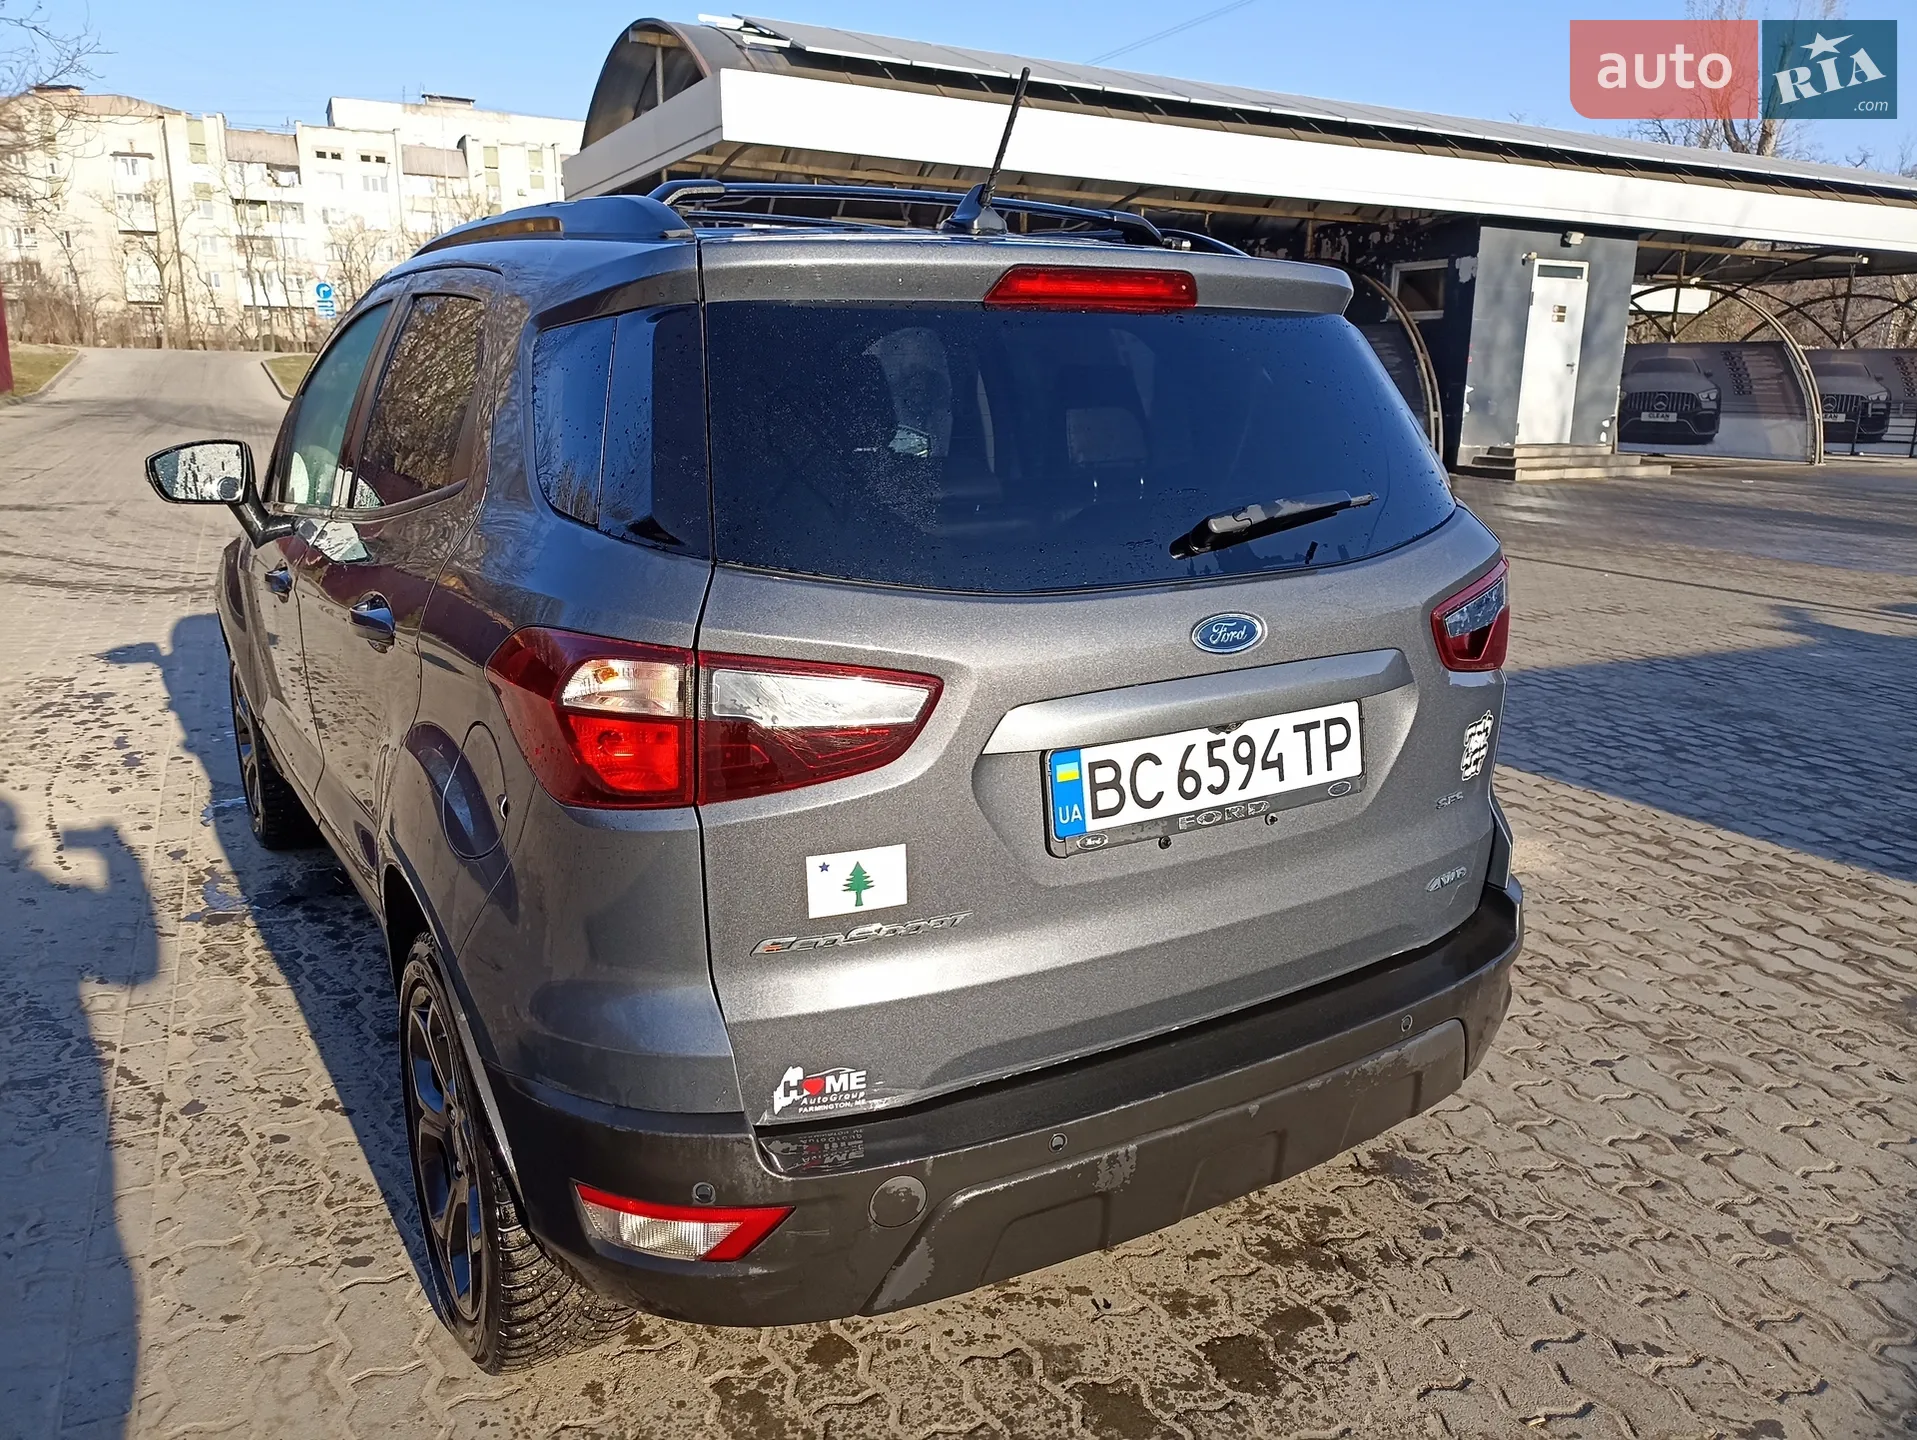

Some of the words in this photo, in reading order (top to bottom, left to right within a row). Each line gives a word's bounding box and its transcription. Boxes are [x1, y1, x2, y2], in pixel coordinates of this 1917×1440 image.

[1209, 622, 1248, 645] Ford
[1088, 752, 1165, 820] BC
[1177, 728, 1285, 801] 6594
[1293, 716, 1351, 776] TP
[1058, 806, 1083, 825] UA
[1178, 800, 1271, 831] FORD
